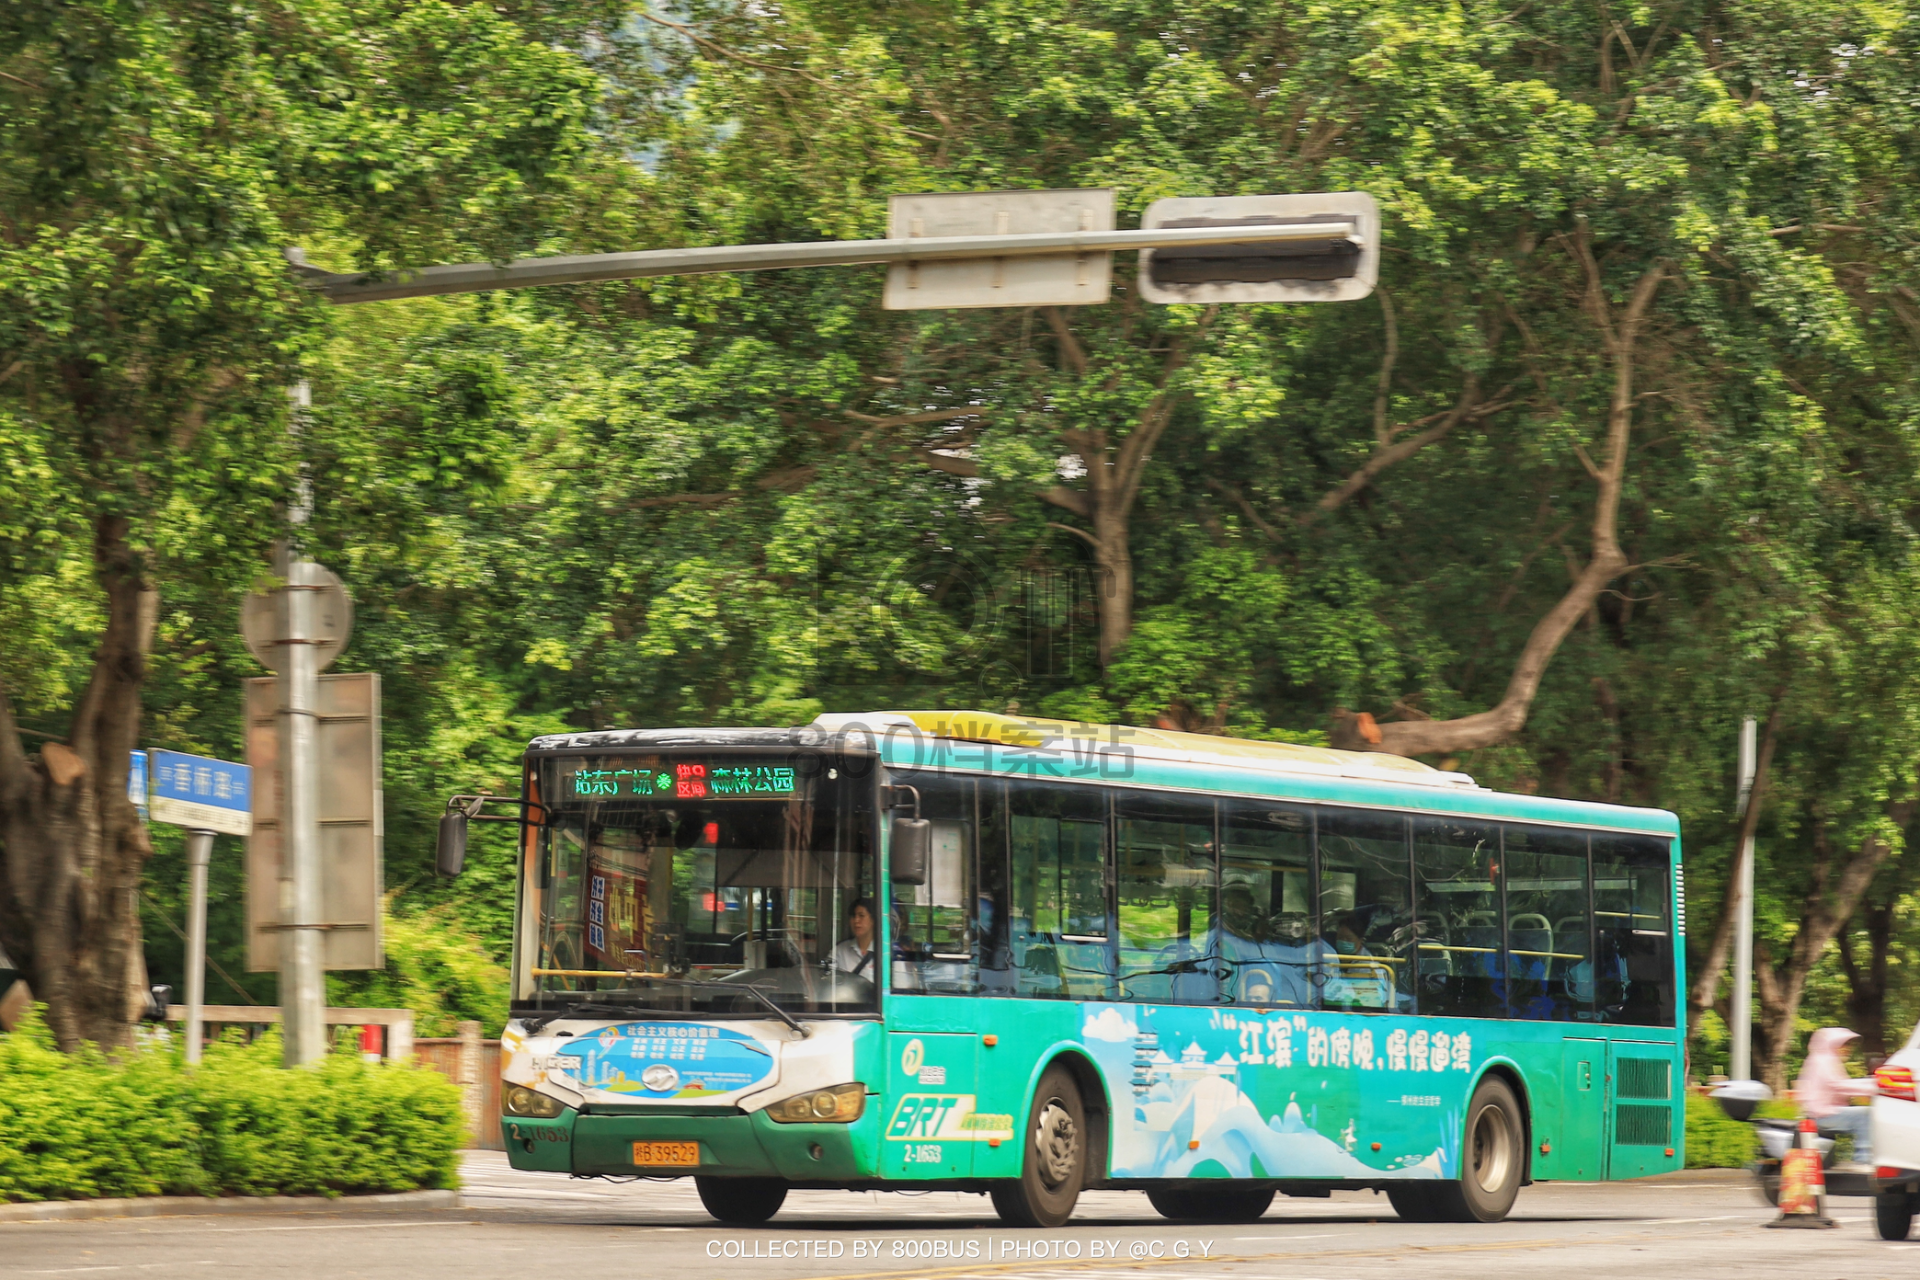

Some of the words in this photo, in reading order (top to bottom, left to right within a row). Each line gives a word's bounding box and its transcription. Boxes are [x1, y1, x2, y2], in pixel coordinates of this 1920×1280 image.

[711, 767, 794, 793] 森林公园
[627, 1025, 719, 1039] 社会主义核心价值观
[887, 1097, 959, 1137] BRT
